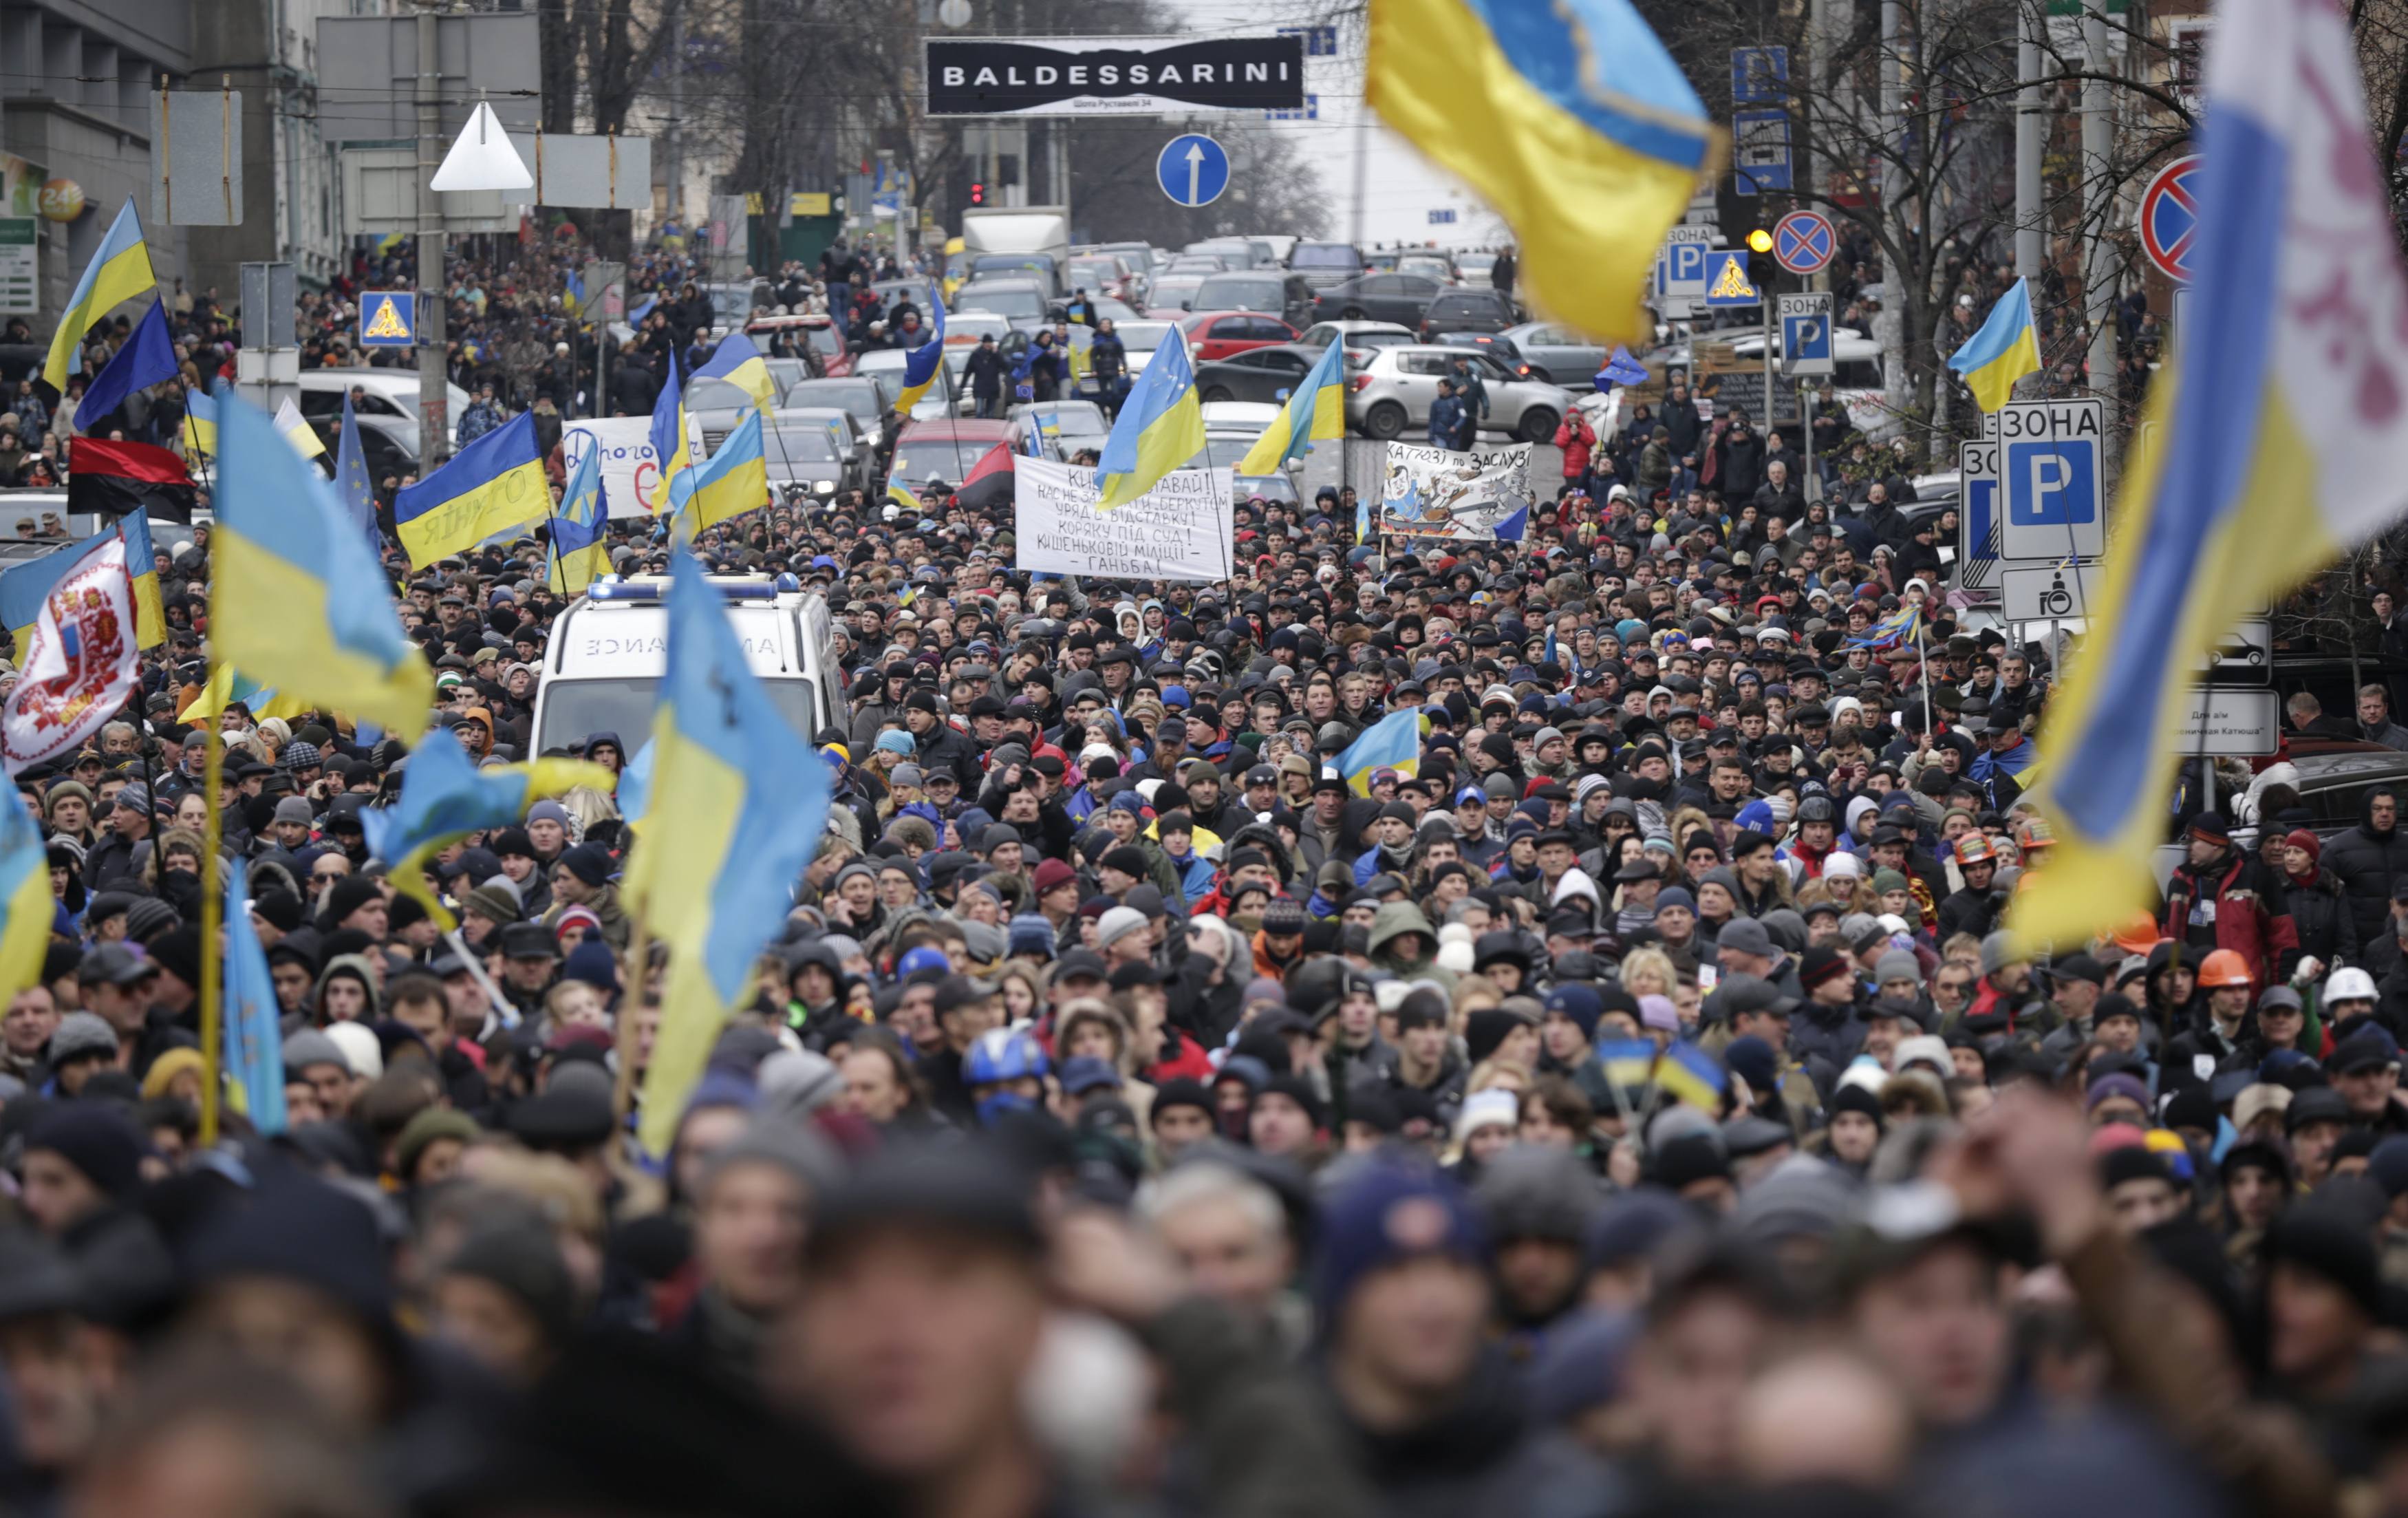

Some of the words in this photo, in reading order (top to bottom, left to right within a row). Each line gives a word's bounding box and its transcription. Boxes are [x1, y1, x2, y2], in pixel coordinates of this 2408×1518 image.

[943, 61, 1289, 88] BALDESSARINI
[43, 187, 69, 205] 24
[1668, 229, 1710, 242] ЗОНА
[1677, 246, 1701, 279] P
[1782, 295, 1831, 314] ЗОНА
[1794, 319, 1821, 356] P
[2003, 407, 2099, 438] ЗОНА
[1965, 449, 1998, 475] ЗО
[1038, 484, 1060, 501] НАС
[1063, 487, 1078, 503] НЕ
[2030, 454, 2072, 514] P
[1055, 502, 1090, 521] УРЯД
[1110, 509, 1196, 526] ВІДСТАВКУ!
[1057, 520, 1111, 539] КОРЯКУ
[1037, 533, 1128, 557] КИШЕНЬКОВІЙ
[1088, 556, 1163, 576] ГАНЬБА!
